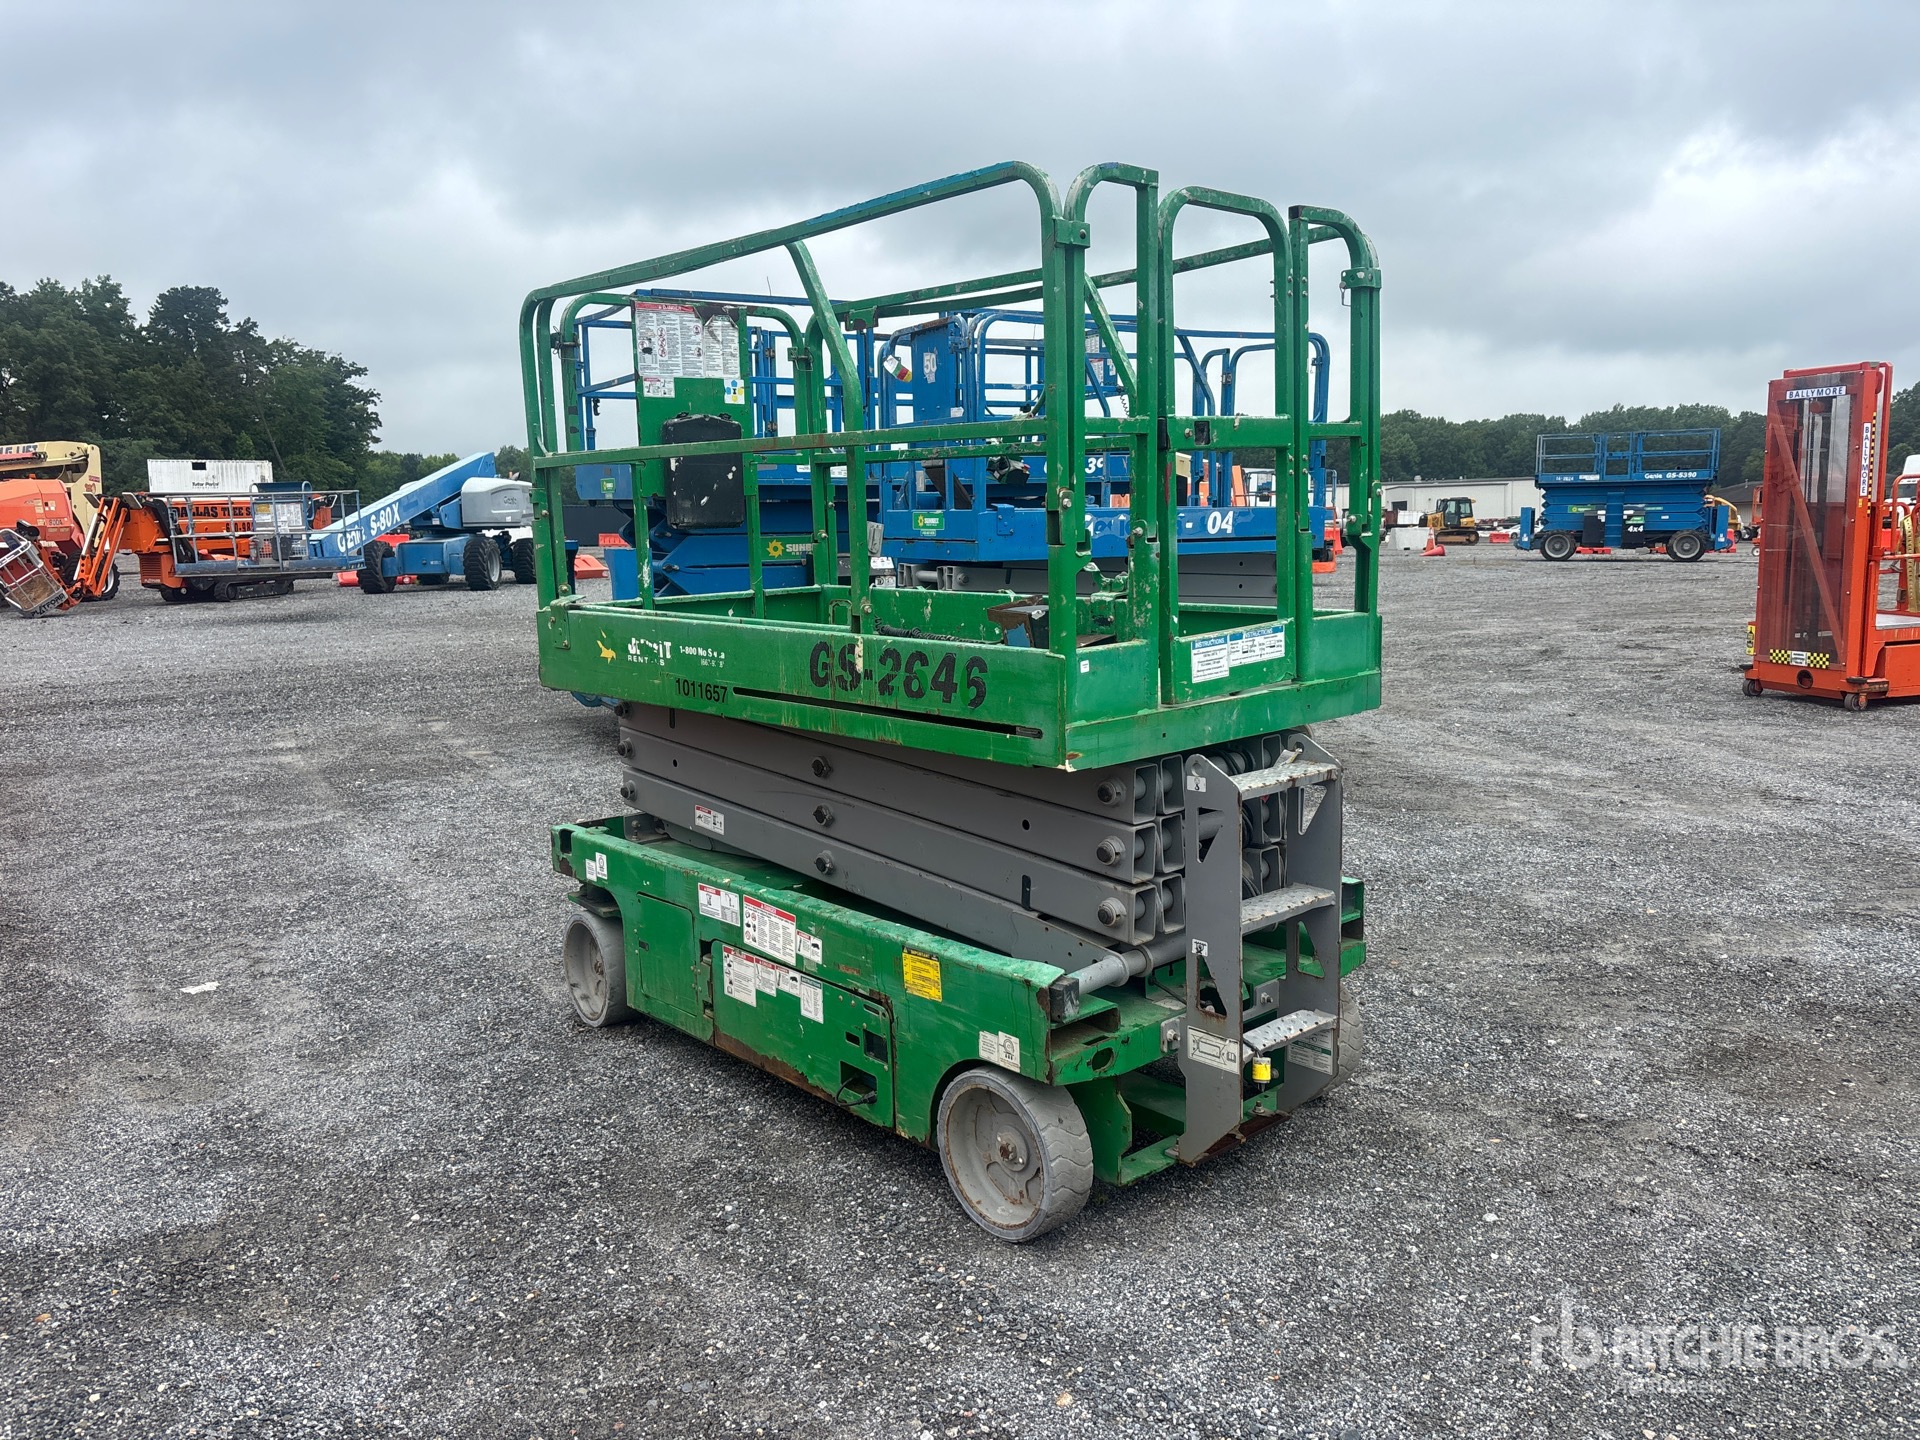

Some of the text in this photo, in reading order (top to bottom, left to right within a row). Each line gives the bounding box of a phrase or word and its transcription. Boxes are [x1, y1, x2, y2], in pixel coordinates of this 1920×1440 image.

[1788, 386, 1843, 399] BALLYMORE
[1861, 426, 1870, 494] BALLYMORE
[1628, 525, 1644, 533] 4x4
[627, 655, 665, 667] RENTS
[809, 641, 988, 709] GS-2646
[676, 678, 728, 704] 1011657
